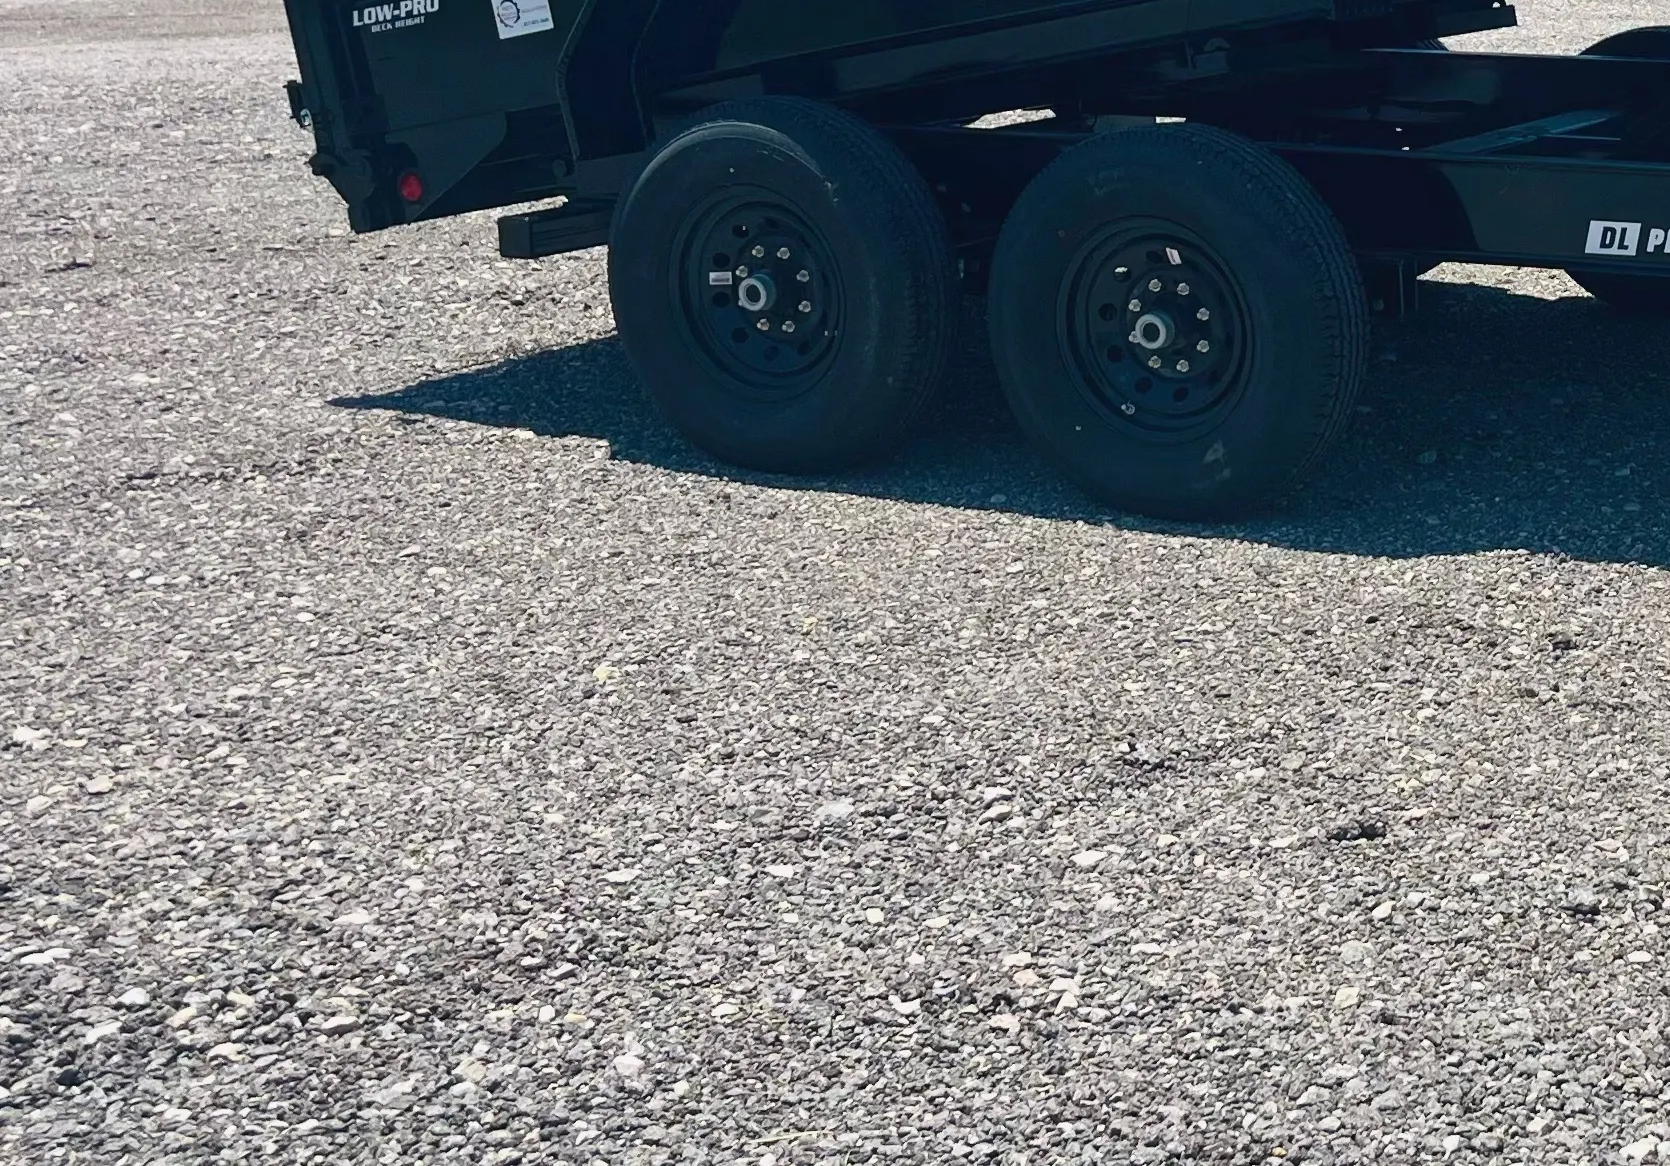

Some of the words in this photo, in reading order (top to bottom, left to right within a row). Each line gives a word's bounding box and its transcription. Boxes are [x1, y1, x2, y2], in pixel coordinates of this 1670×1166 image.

[371, 22, 393, 33] DECK
[395, 15, 425, 28] HEIGHT
[1599, 226, 1630, 250] DL
